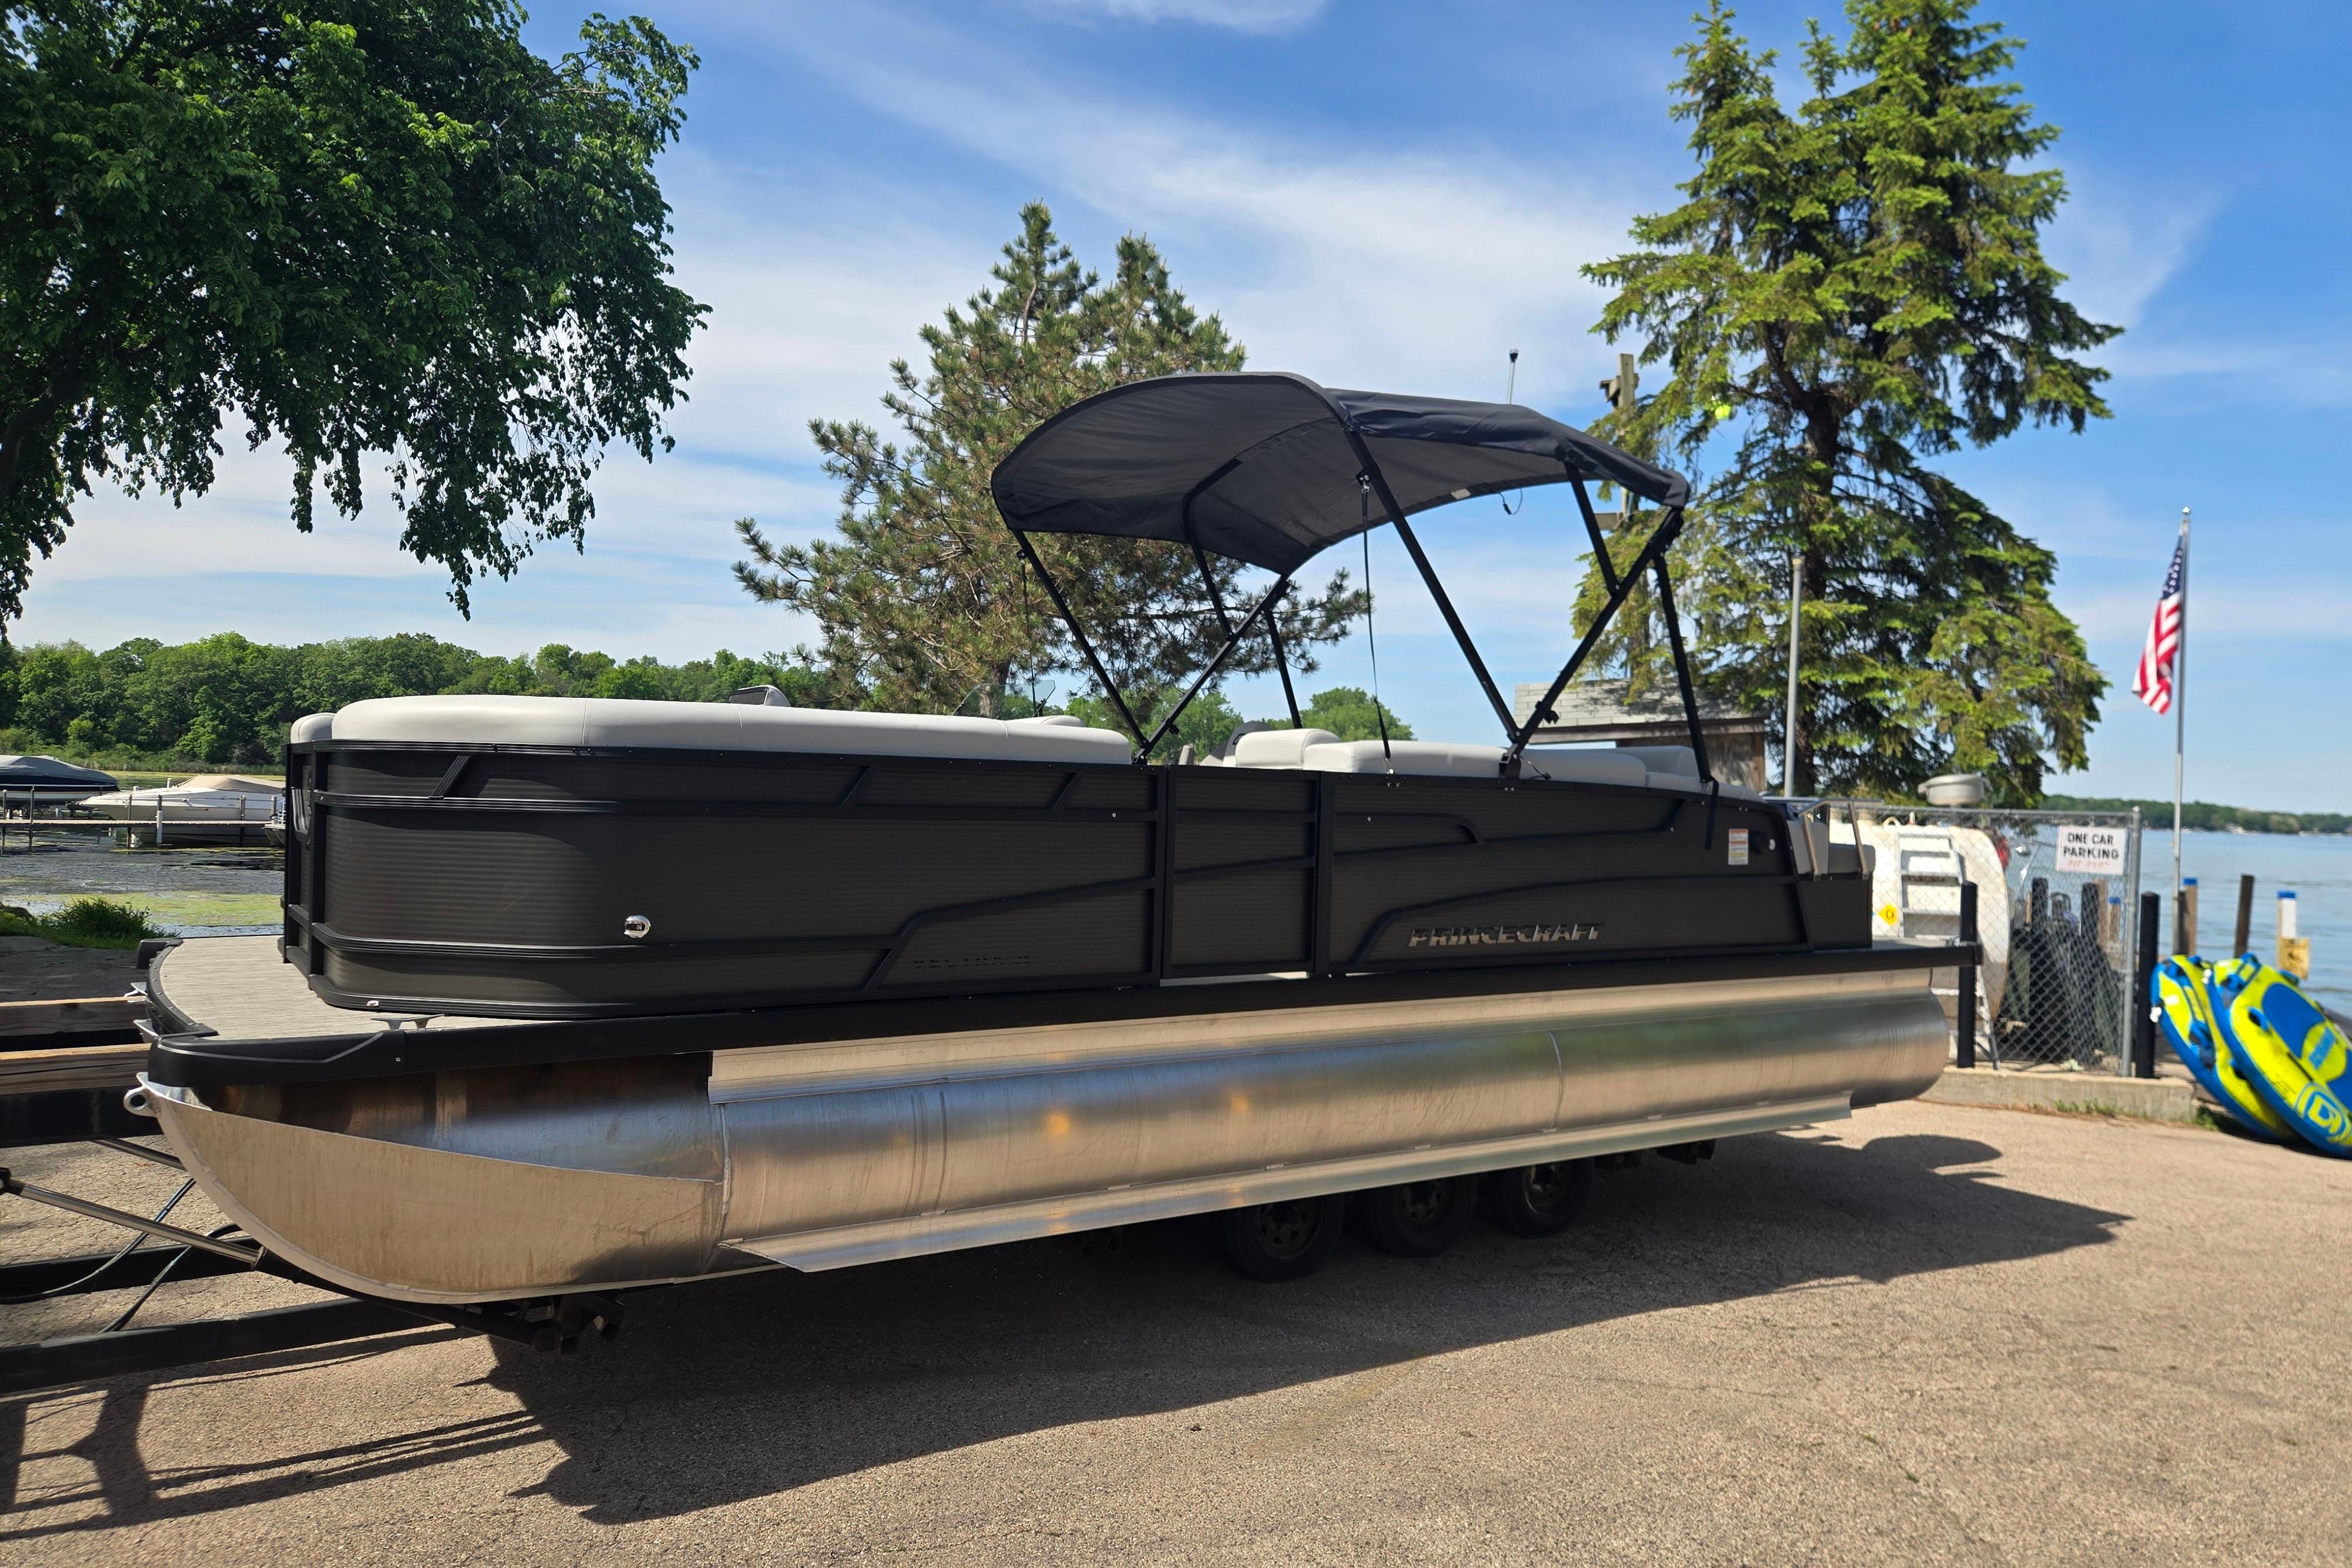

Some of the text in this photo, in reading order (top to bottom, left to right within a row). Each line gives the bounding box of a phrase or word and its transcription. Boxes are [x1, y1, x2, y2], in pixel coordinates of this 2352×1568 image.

[2067, 832, 2114, 847] ONE CAR
[2063, 847, 2119, 860] PARKING
[1408, 923, 1605, 947] PRINCECRAFT
